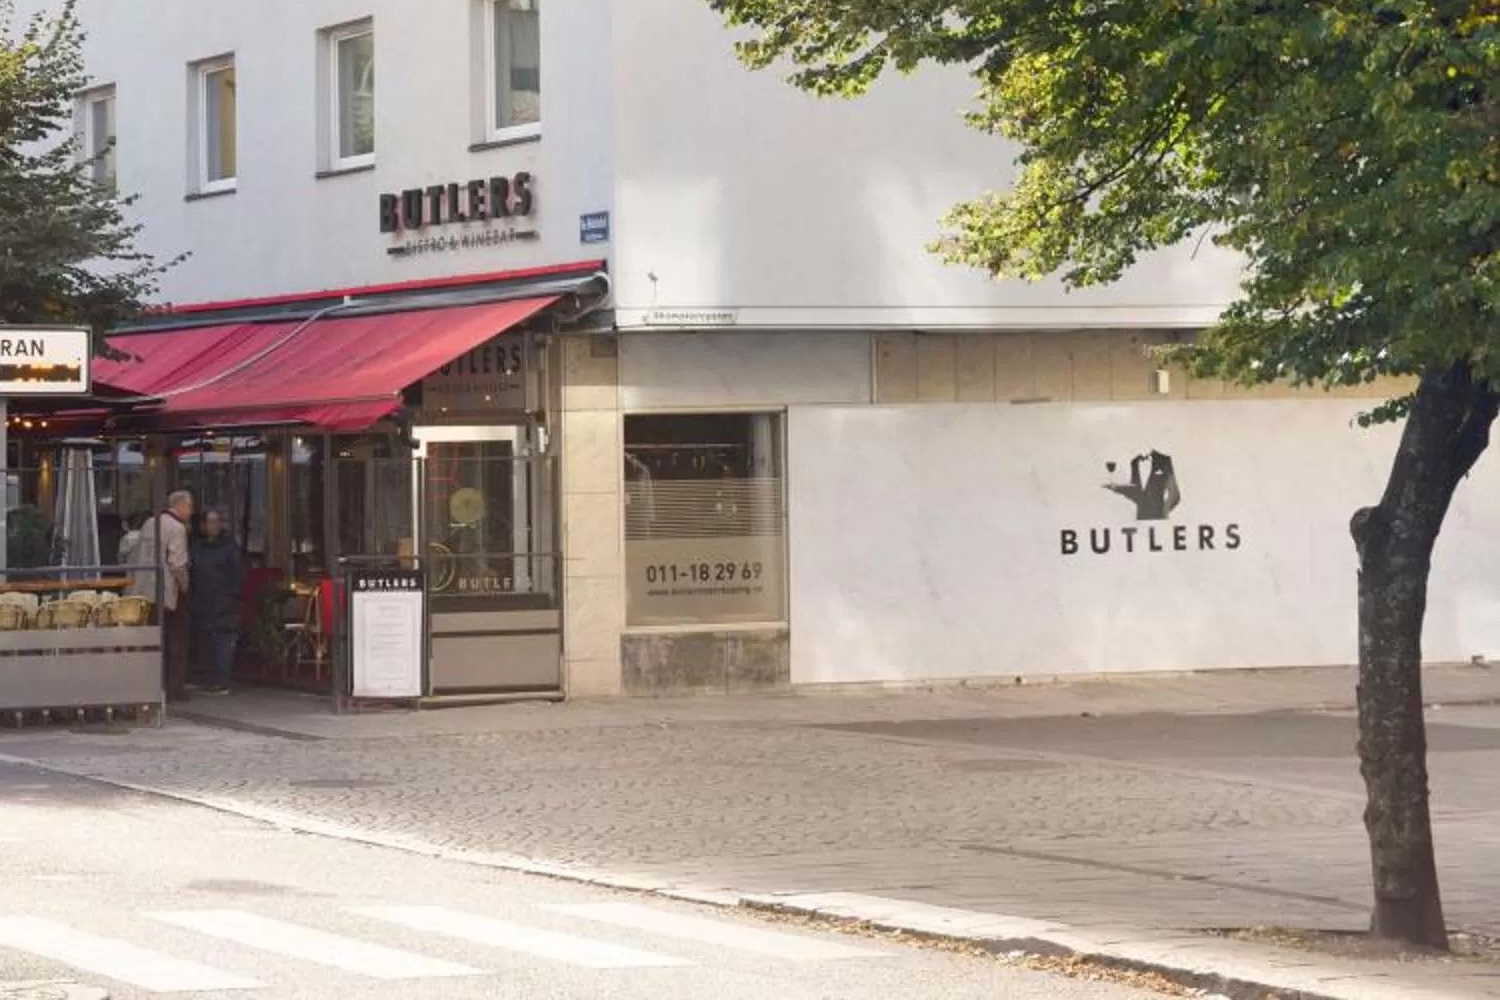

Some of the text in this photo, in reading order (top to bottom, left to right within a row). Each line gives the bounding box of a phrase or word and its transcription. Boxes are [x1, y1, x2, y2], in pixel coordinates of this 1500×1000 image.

[379, 172, 534, 233] BUTLERS
[1060, 523, 1242, 555] BUTLERS
[358, 578, 417, 589] BUTLERS
[645, 560, 763, 583] 011-18 29 69
